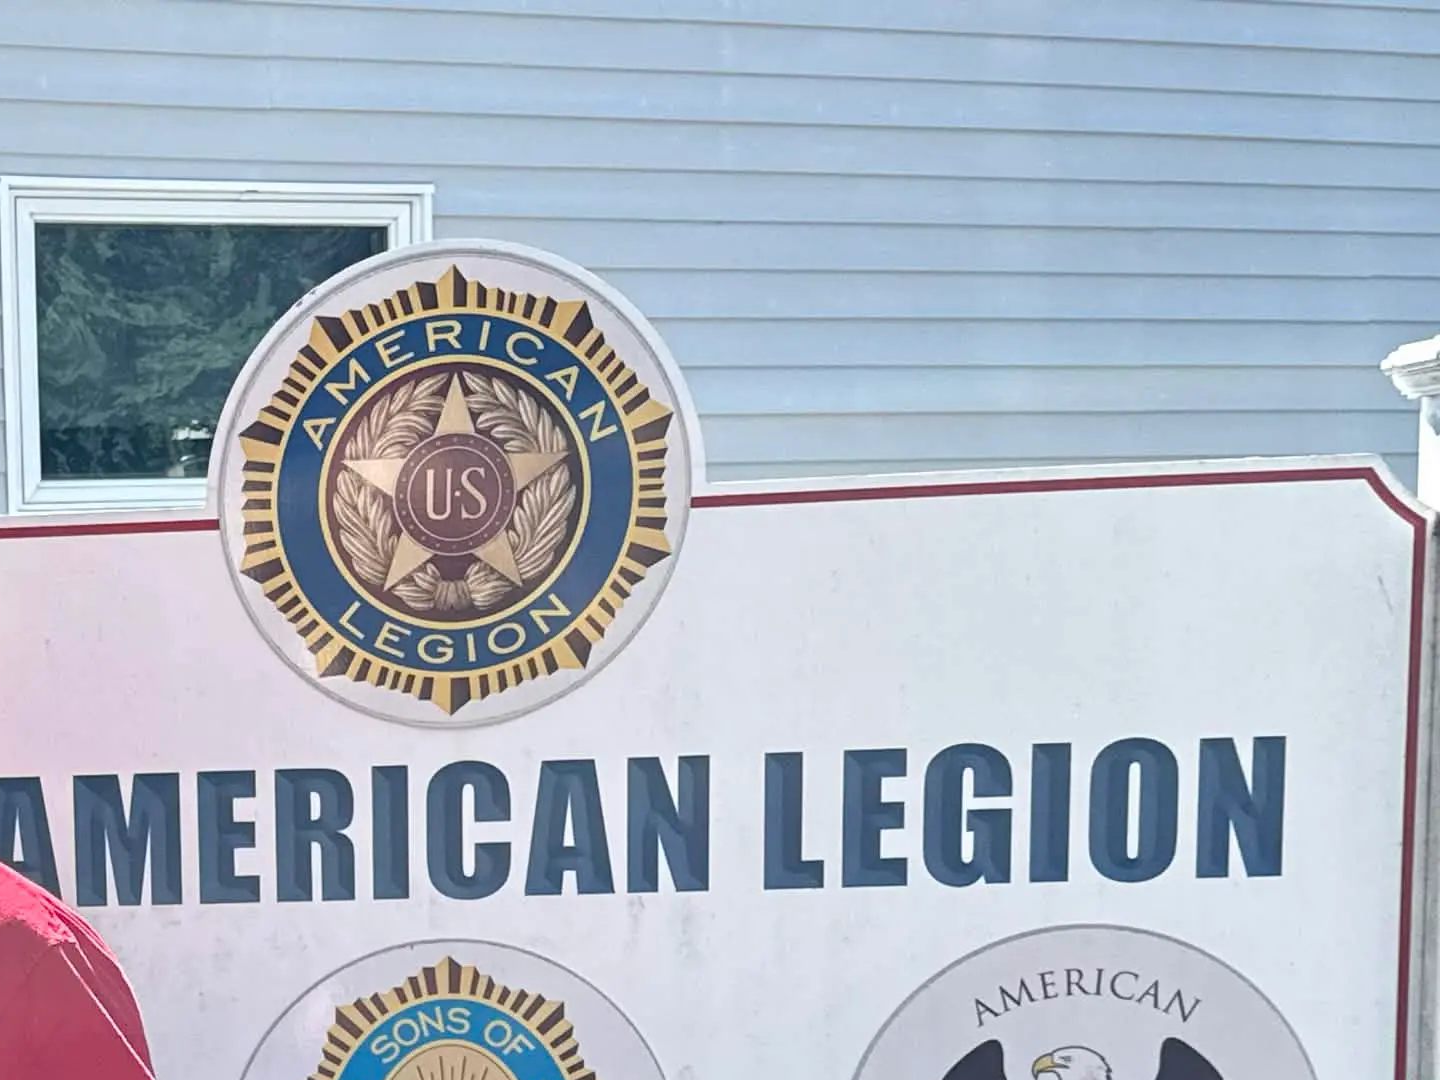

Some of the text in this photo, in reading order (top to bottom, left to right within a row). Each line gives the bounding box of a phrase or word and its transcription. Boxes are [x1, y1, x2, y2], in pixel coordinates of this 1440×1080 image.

[303, 320, 619, 450] AMERICAN
[339, 594, 573, 664] LEGION
[762, 735, 1287, 890] LEGION
[971, 967, 1202, 1028] AMERICAN
[370, 1006, 536, 1064] SONS OF
